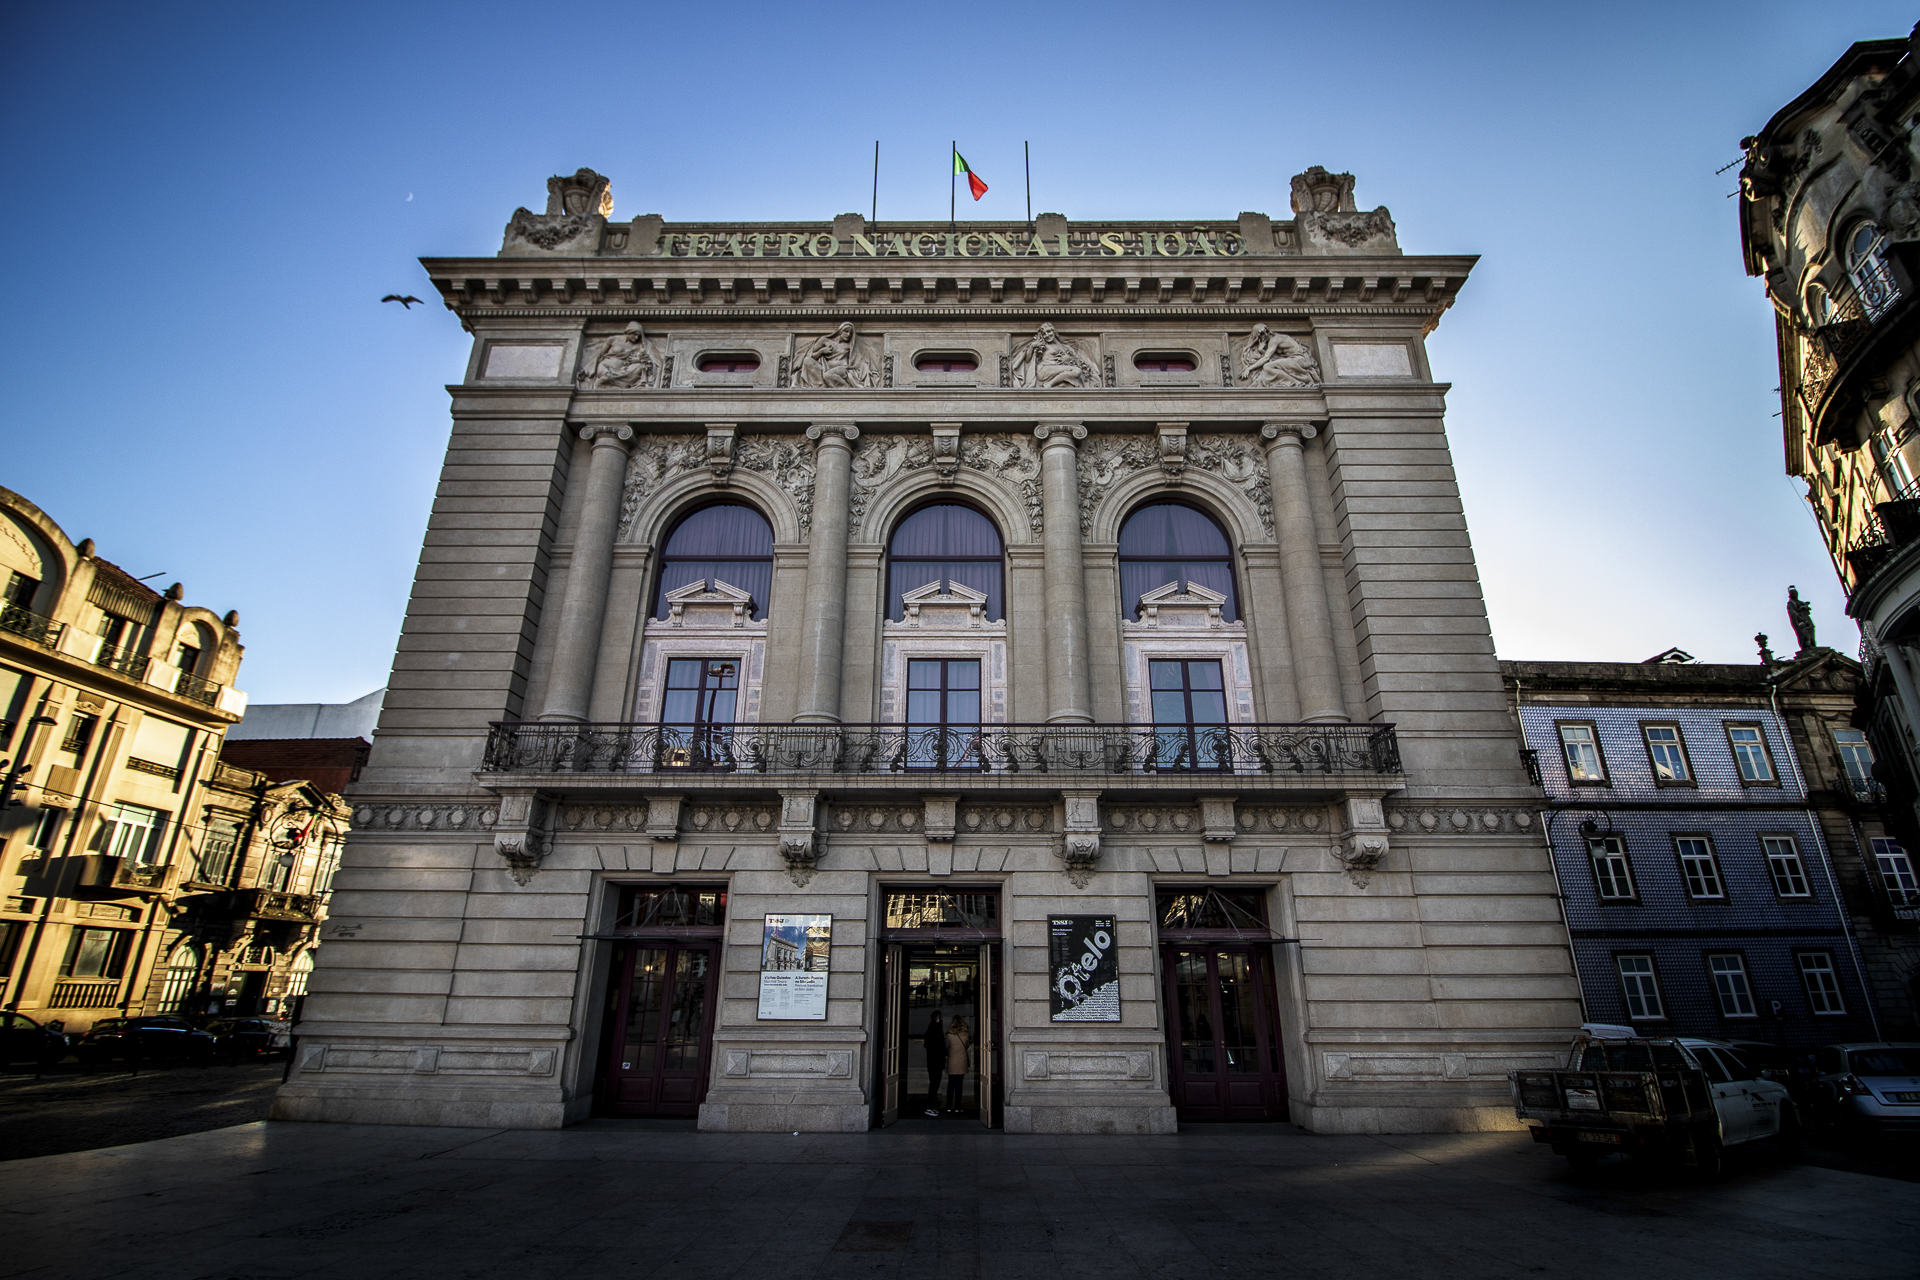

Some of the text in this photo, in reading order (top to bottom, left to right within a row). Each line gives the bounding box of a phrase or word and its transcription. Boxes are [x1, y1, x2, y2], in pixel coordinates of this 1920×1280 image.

[657, 233, 839, 258] TEATRO
[850, 233, 1086, 258] NACIONAL
[1770, 1000, 1782, 1015] P
[1578, 1132, 1616, 1144] 66-33-SE
